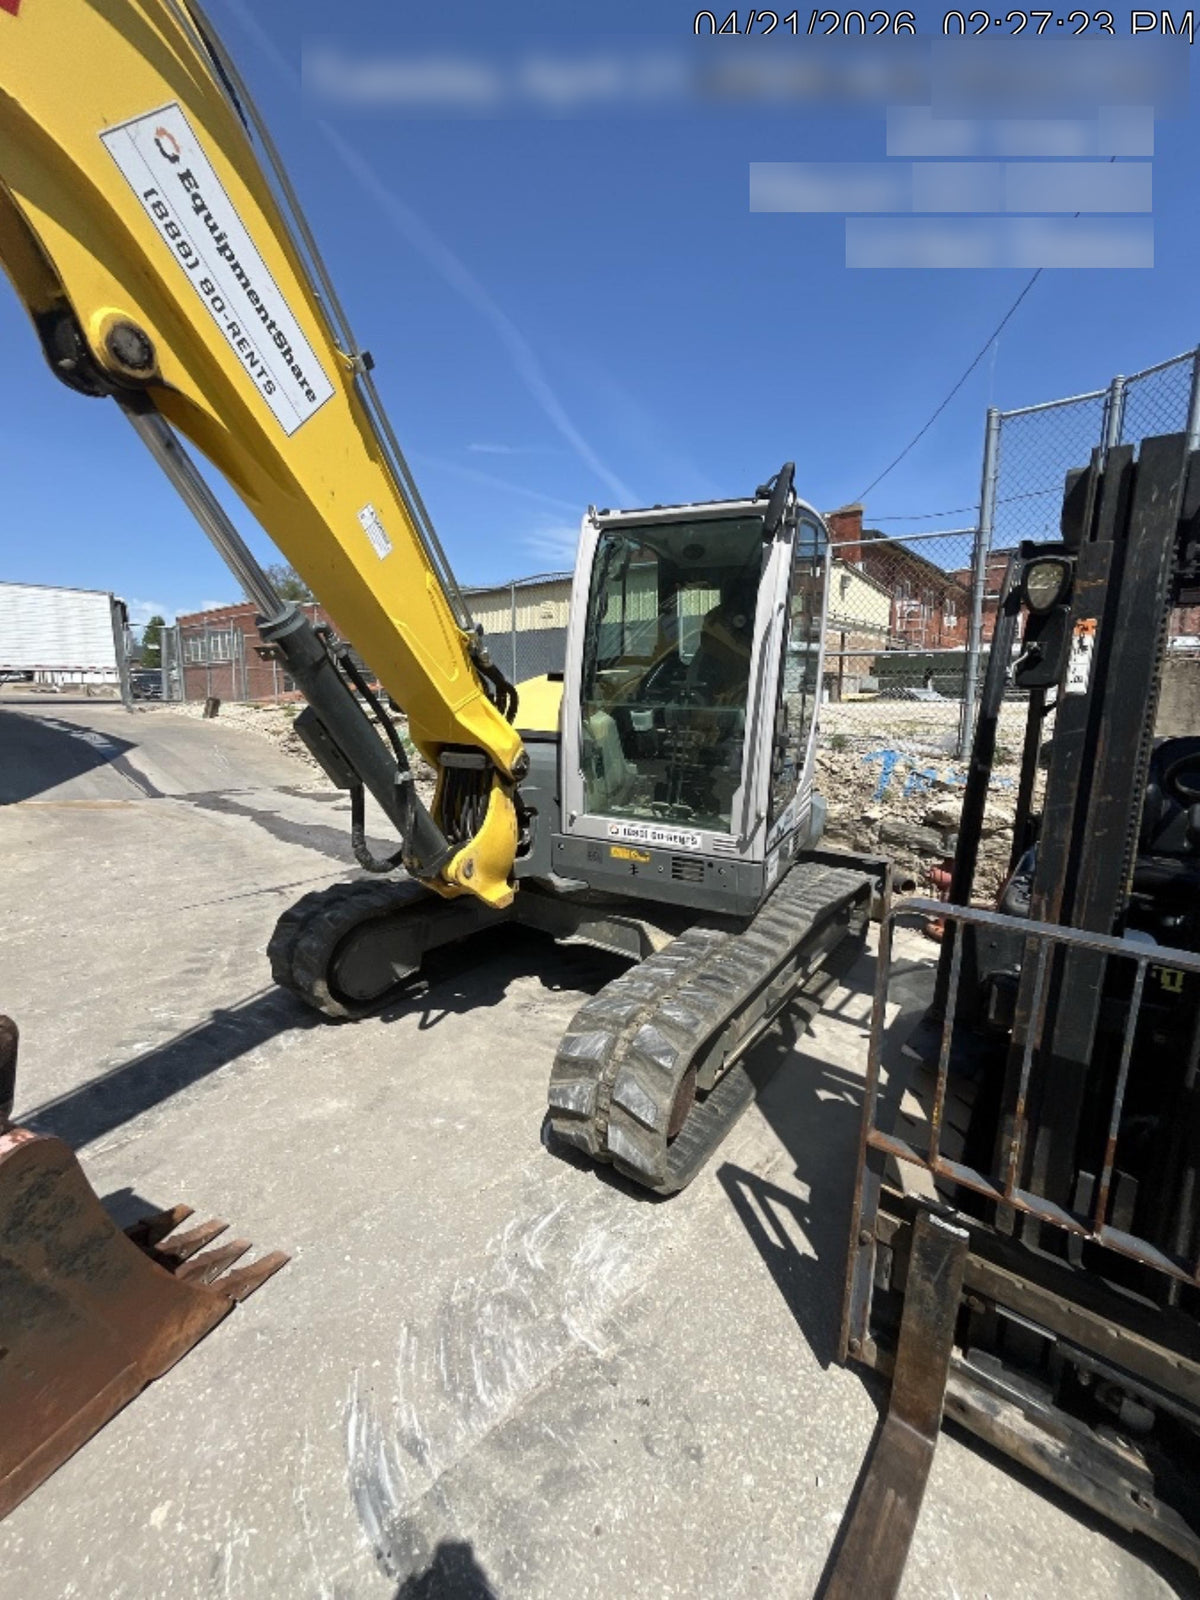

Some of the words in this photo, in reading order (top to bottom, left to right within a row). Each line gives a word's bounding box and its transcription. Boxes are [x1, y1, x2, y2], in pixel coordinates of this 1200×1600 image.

[143, 187, 200, 272] (888)
[198, 276, 276, 396] 80-RENTS
[177, 168, 317, 404] EquipmentShare
